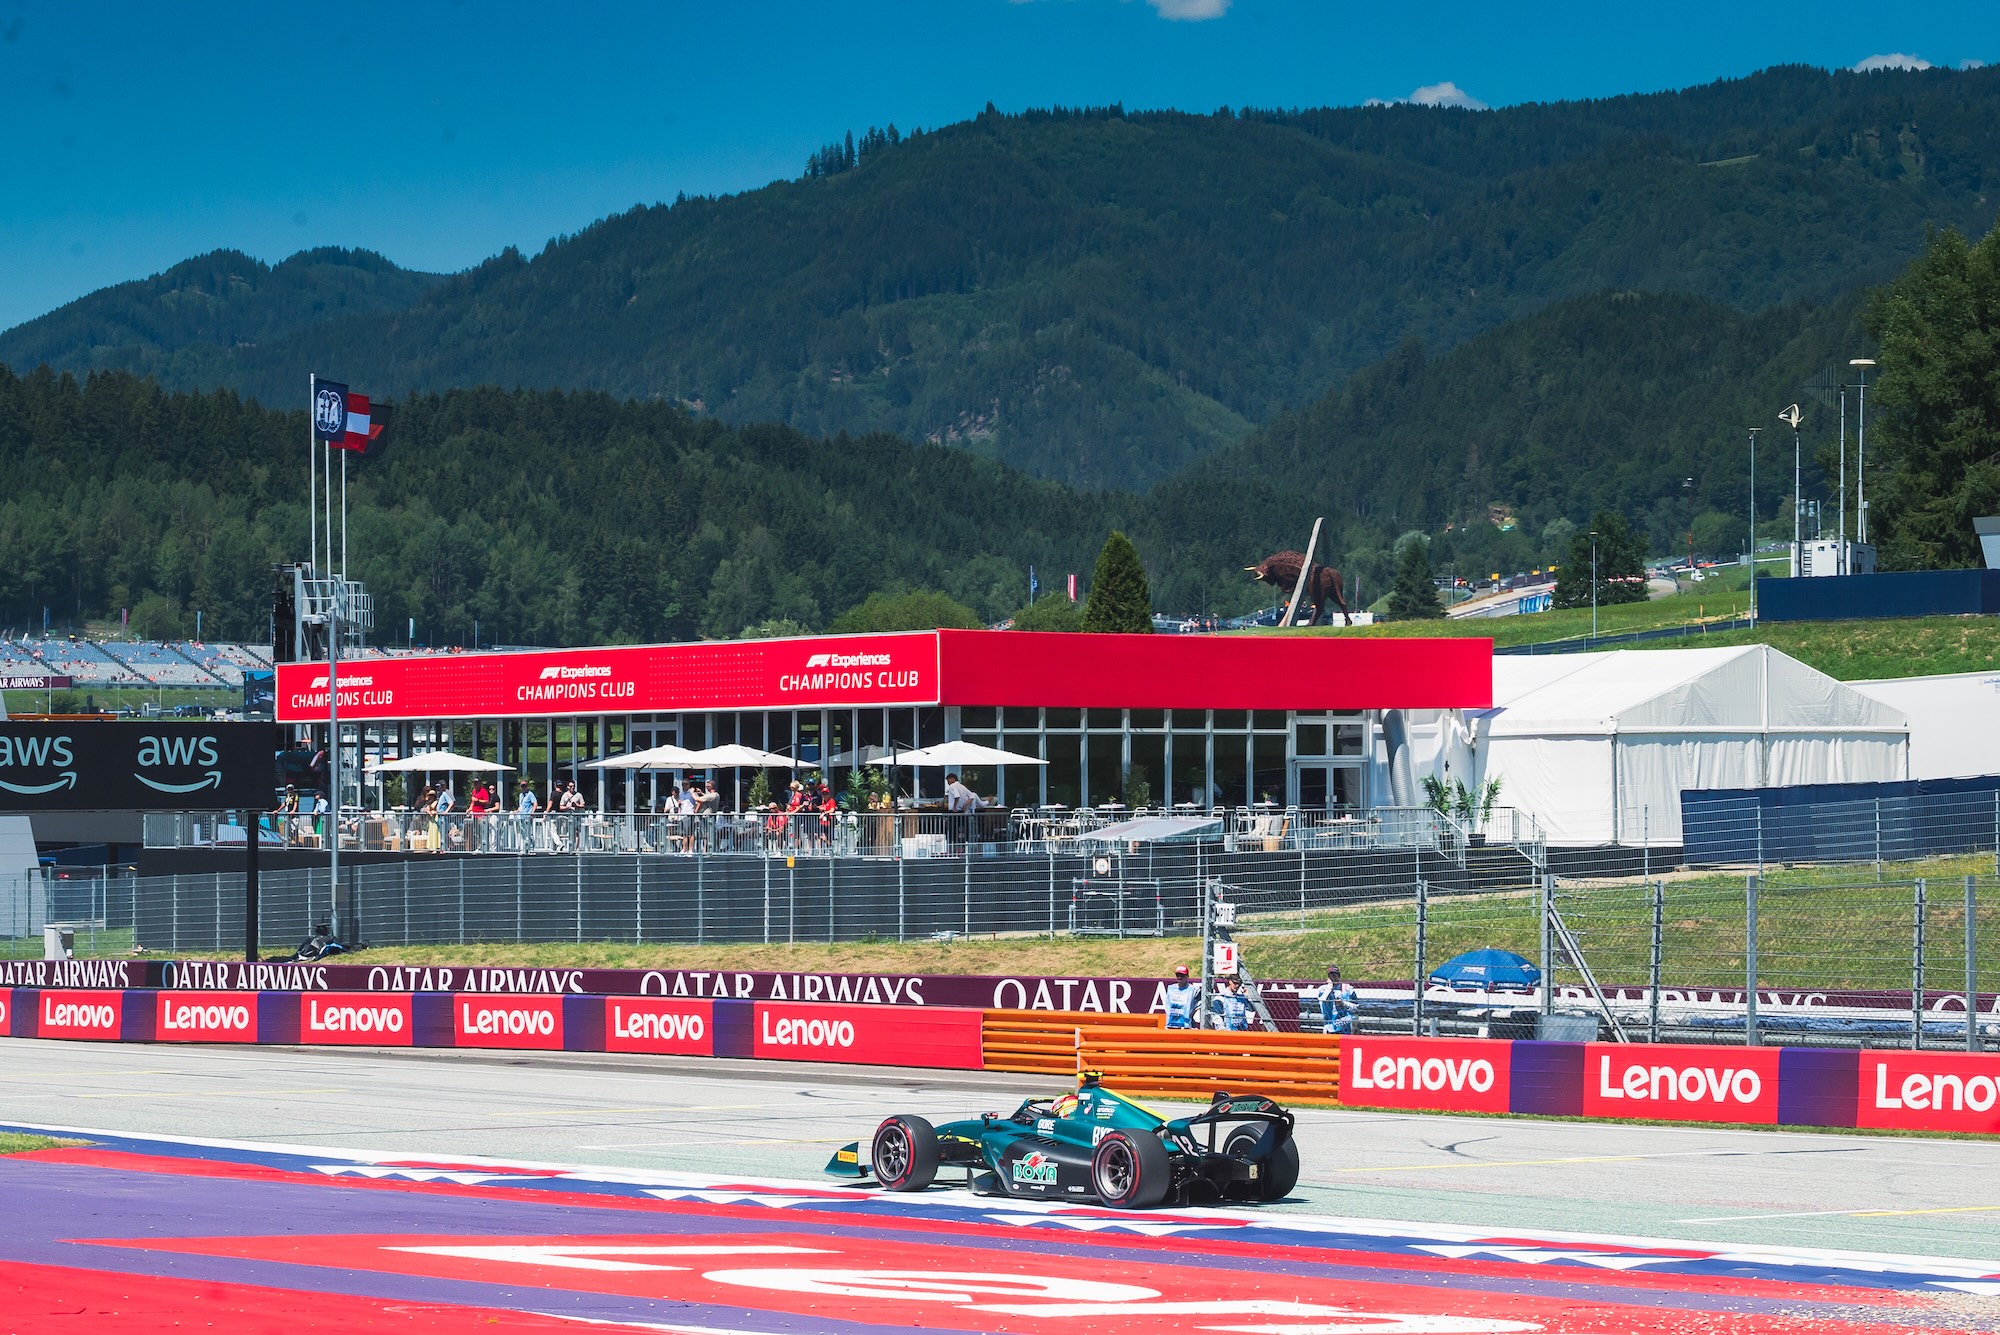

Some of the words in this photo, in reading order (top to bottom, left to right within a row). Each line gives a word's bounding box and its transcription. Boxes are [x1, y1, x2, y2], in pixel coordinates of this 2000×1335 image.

[316, 397, 340, 425] FIA
[539, 666, 561, 679] F1
[560, 664, 612, 679] Experiences
[805, 654, 832, 668] F1
[831, 652, 891, 668] Experiences
[9, 677, 45, 688] AIRWAYS
[517, 682, 596, 701] CHAMPIONS
[600, 681, 635, 697] CLUB
[780, 672, 873, 691] CHAMPIONS
[877, 670, 919, 688] CLUB
[291, 692, 359, 708] CHAMPONS
[363, 690, 393, 705] CLUB
[0, 736, 73, 767] aws
[137, 736, 219, 767] aws
[0, 962, 46, 985] ATAR
[52, 960, 129, 988] AIRWAYS
[162, 961, 228, 989] QATAR
[236, 963, 328, 990] AIRWAYS
[368, 966, 453, 992] QATAR
[463, 968, 584, 994] AIRWAYS
[640, 971, 754, 999] QATAR
[769, 974, 925, 1005] AIRWAYS
[993, 978, 1133, 1014] QATAR
[45, 997, 114, 1028] Lenovo
[164, 1000, 249, 1029] Lenovo
[310, 1000, 403, 1032] Lenovo
[463, 1003, 554, 1035] Lenovo
[614, 1006, 704, 1041] Lenovo
[762, 1011, 854, 1047] Lenovo
[1352, 1048, 1494, 1092] Lenovo
[1601, 1055, 1761, 1104] Lenovo
[1876, 1063, 2000, 1112] Leno
[1037, 1119, 1056, 1130] GORE
[1172, 1135, 1200, 1157] 12
[1012, 1164, 1058, 1182] BOYA
